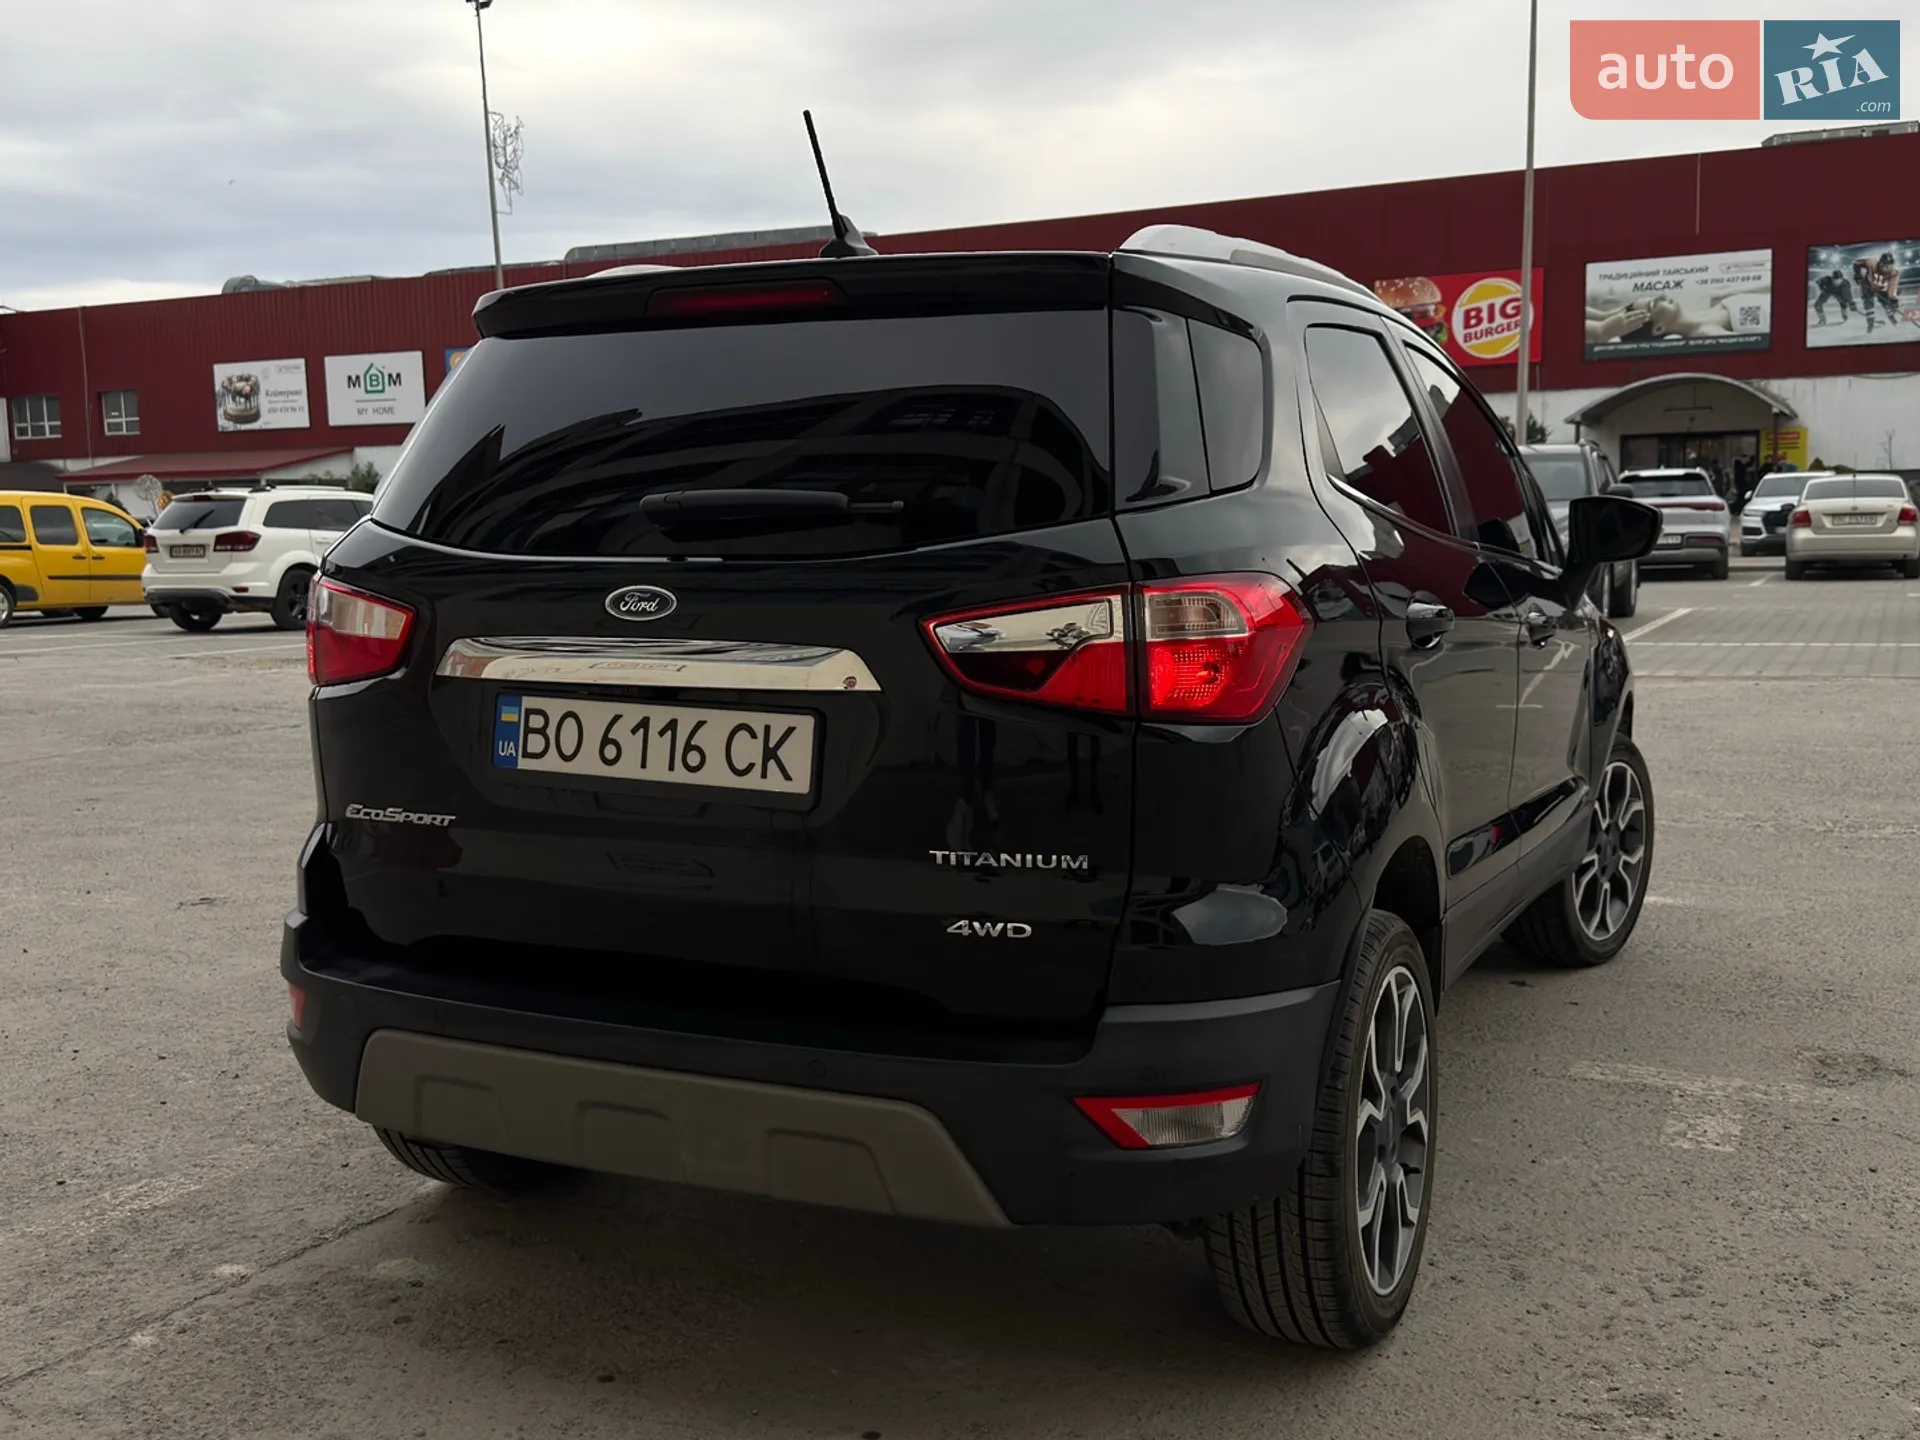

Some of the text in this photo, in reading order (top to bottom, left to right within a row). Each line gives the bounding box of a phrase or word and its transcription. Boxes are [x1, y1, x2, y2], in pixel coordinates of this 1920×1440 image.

[1632, 279, 1684, 293] МАСАЖ
[1463, 298, 1522, 330] BIG
[357, 406, 396, 416] MY HOME
[620, 592, 660, 612] Ford
[498, 740, 517, 757] UA
[521, 707, 797, 782] BO 6116 CK
[929, 850, 1089, 870] TITANIUM
[946, 919, 1033, 938] 4WD
